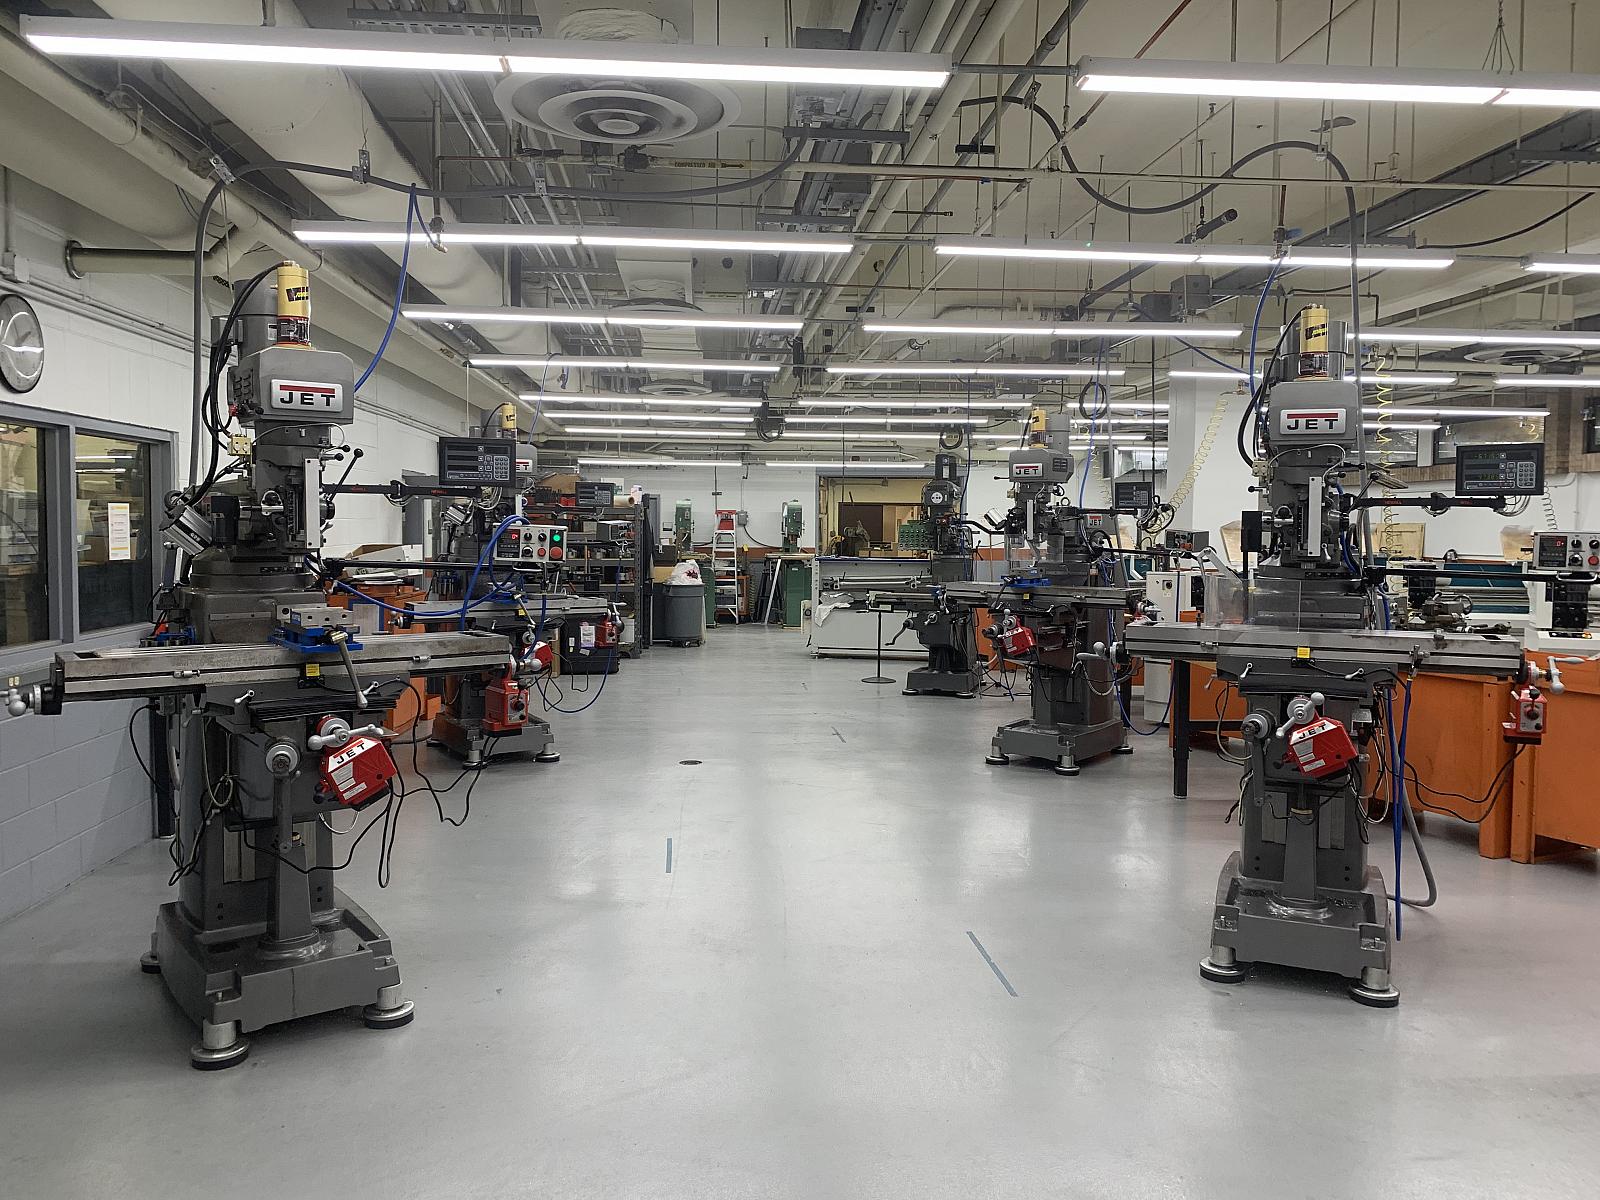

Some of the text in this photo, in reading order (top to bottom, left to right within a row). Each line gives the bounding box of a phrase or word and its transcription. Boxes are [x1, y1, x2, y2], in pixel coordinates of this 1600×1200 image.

[280, 391, 336, 407] JET
[1286, 418, 1339, 431] JET
[1299, 724, 1327, 740] JET
[336, 742, 365, 764] JET
